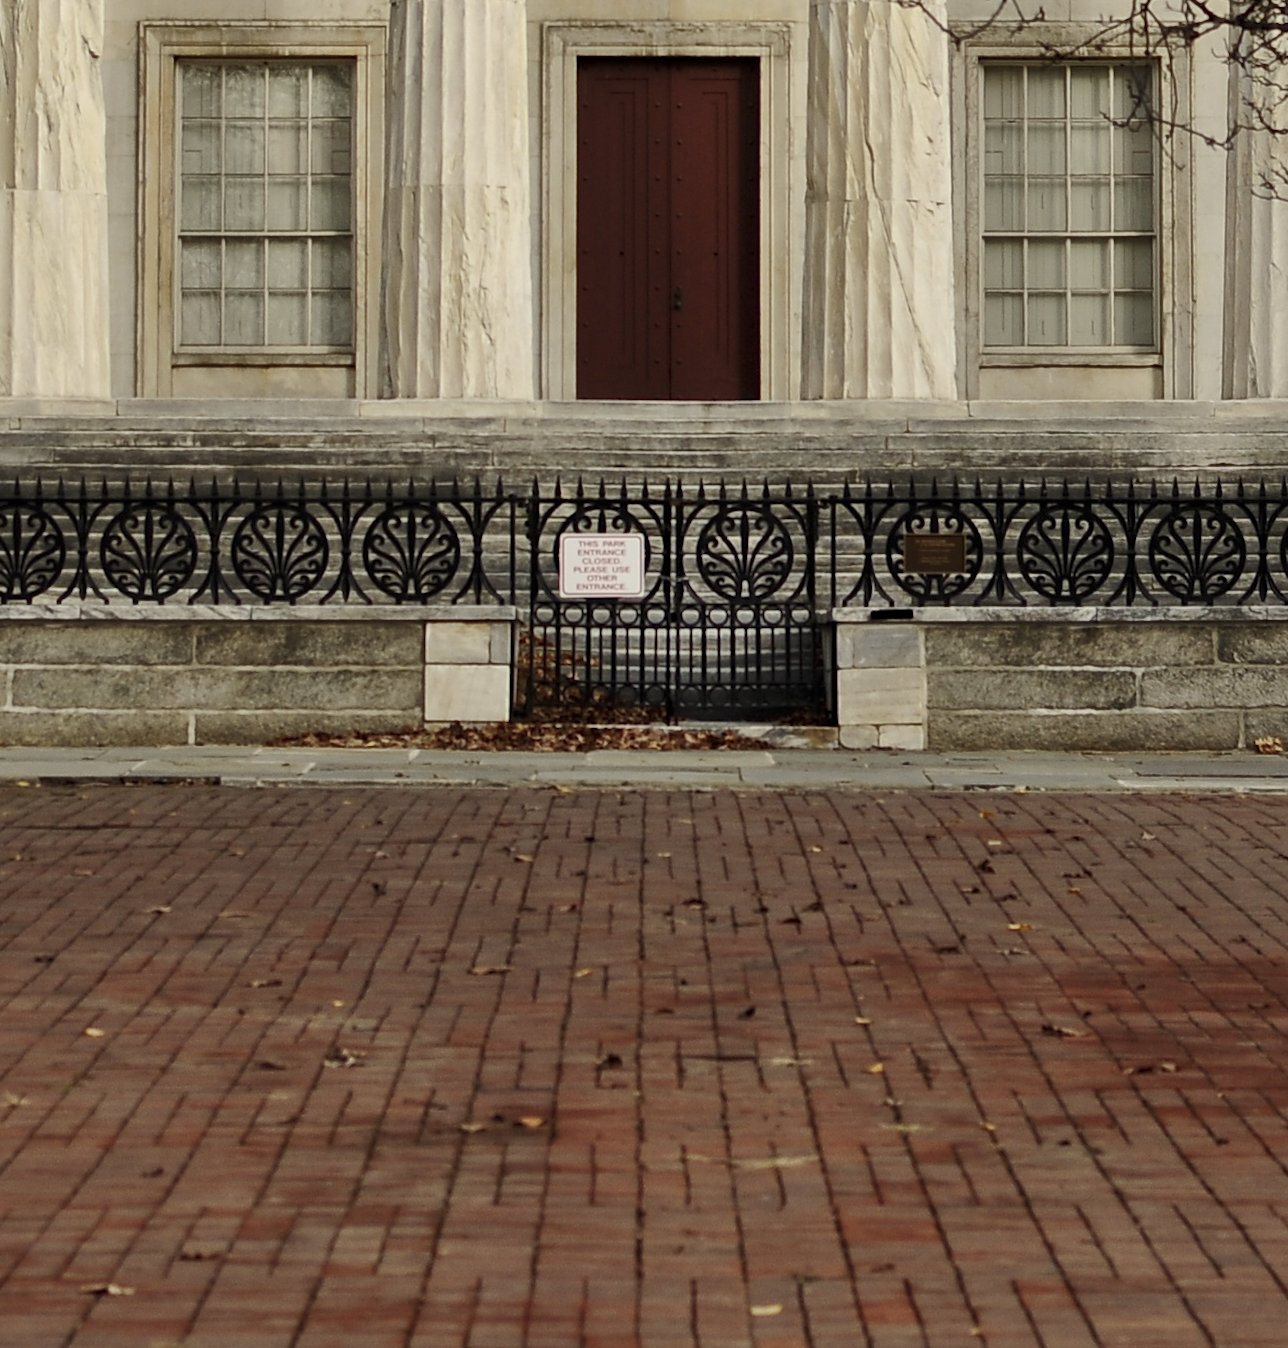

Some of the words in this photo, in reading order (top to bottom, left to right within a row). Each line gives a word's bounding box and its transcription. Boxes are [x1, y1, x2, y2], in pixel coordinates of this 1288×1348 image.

[578, 540, 599, 548] THIS
[602, 540, 626, 548] PARK
[586, 574, 618, 582] OTHER
